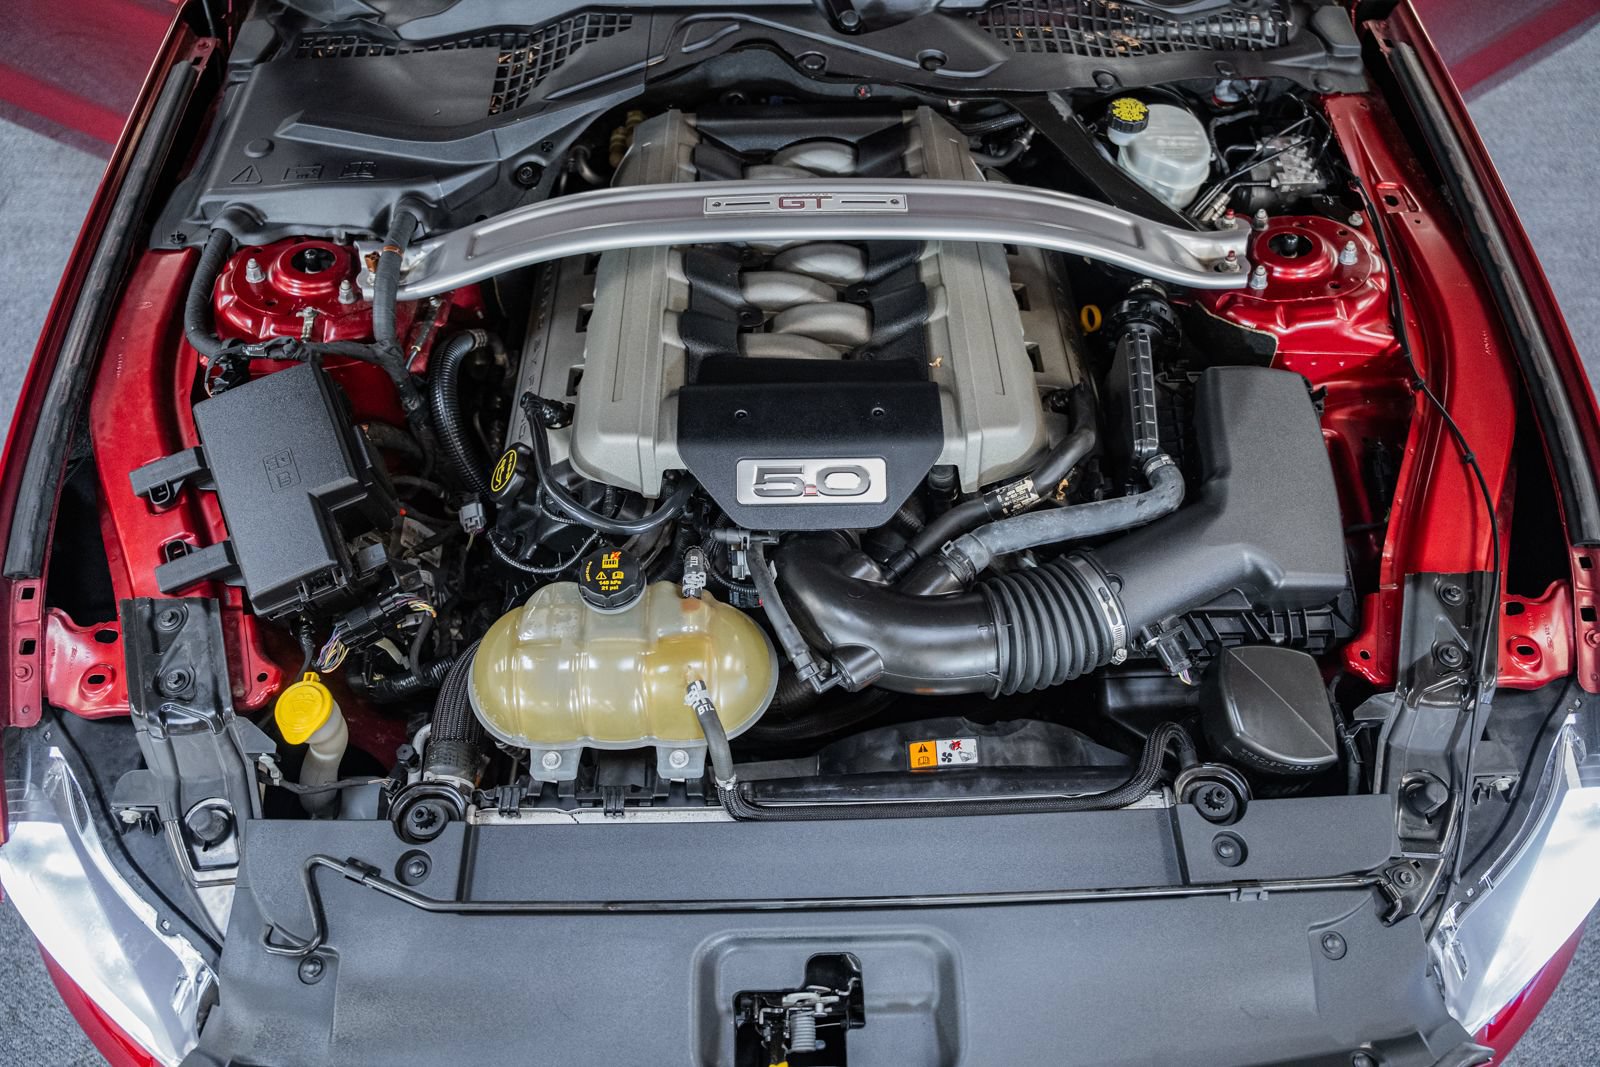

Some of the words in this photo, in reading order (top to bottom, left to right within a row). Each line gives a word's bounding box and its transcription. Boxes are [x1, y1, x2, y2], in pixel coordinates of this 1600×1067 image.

[778, 195, 833, 209] GT
[752, 464, 871, 498] 5.0
[690, 555, 698, 567] BTL
[698, 704, 714, 715] BTL
